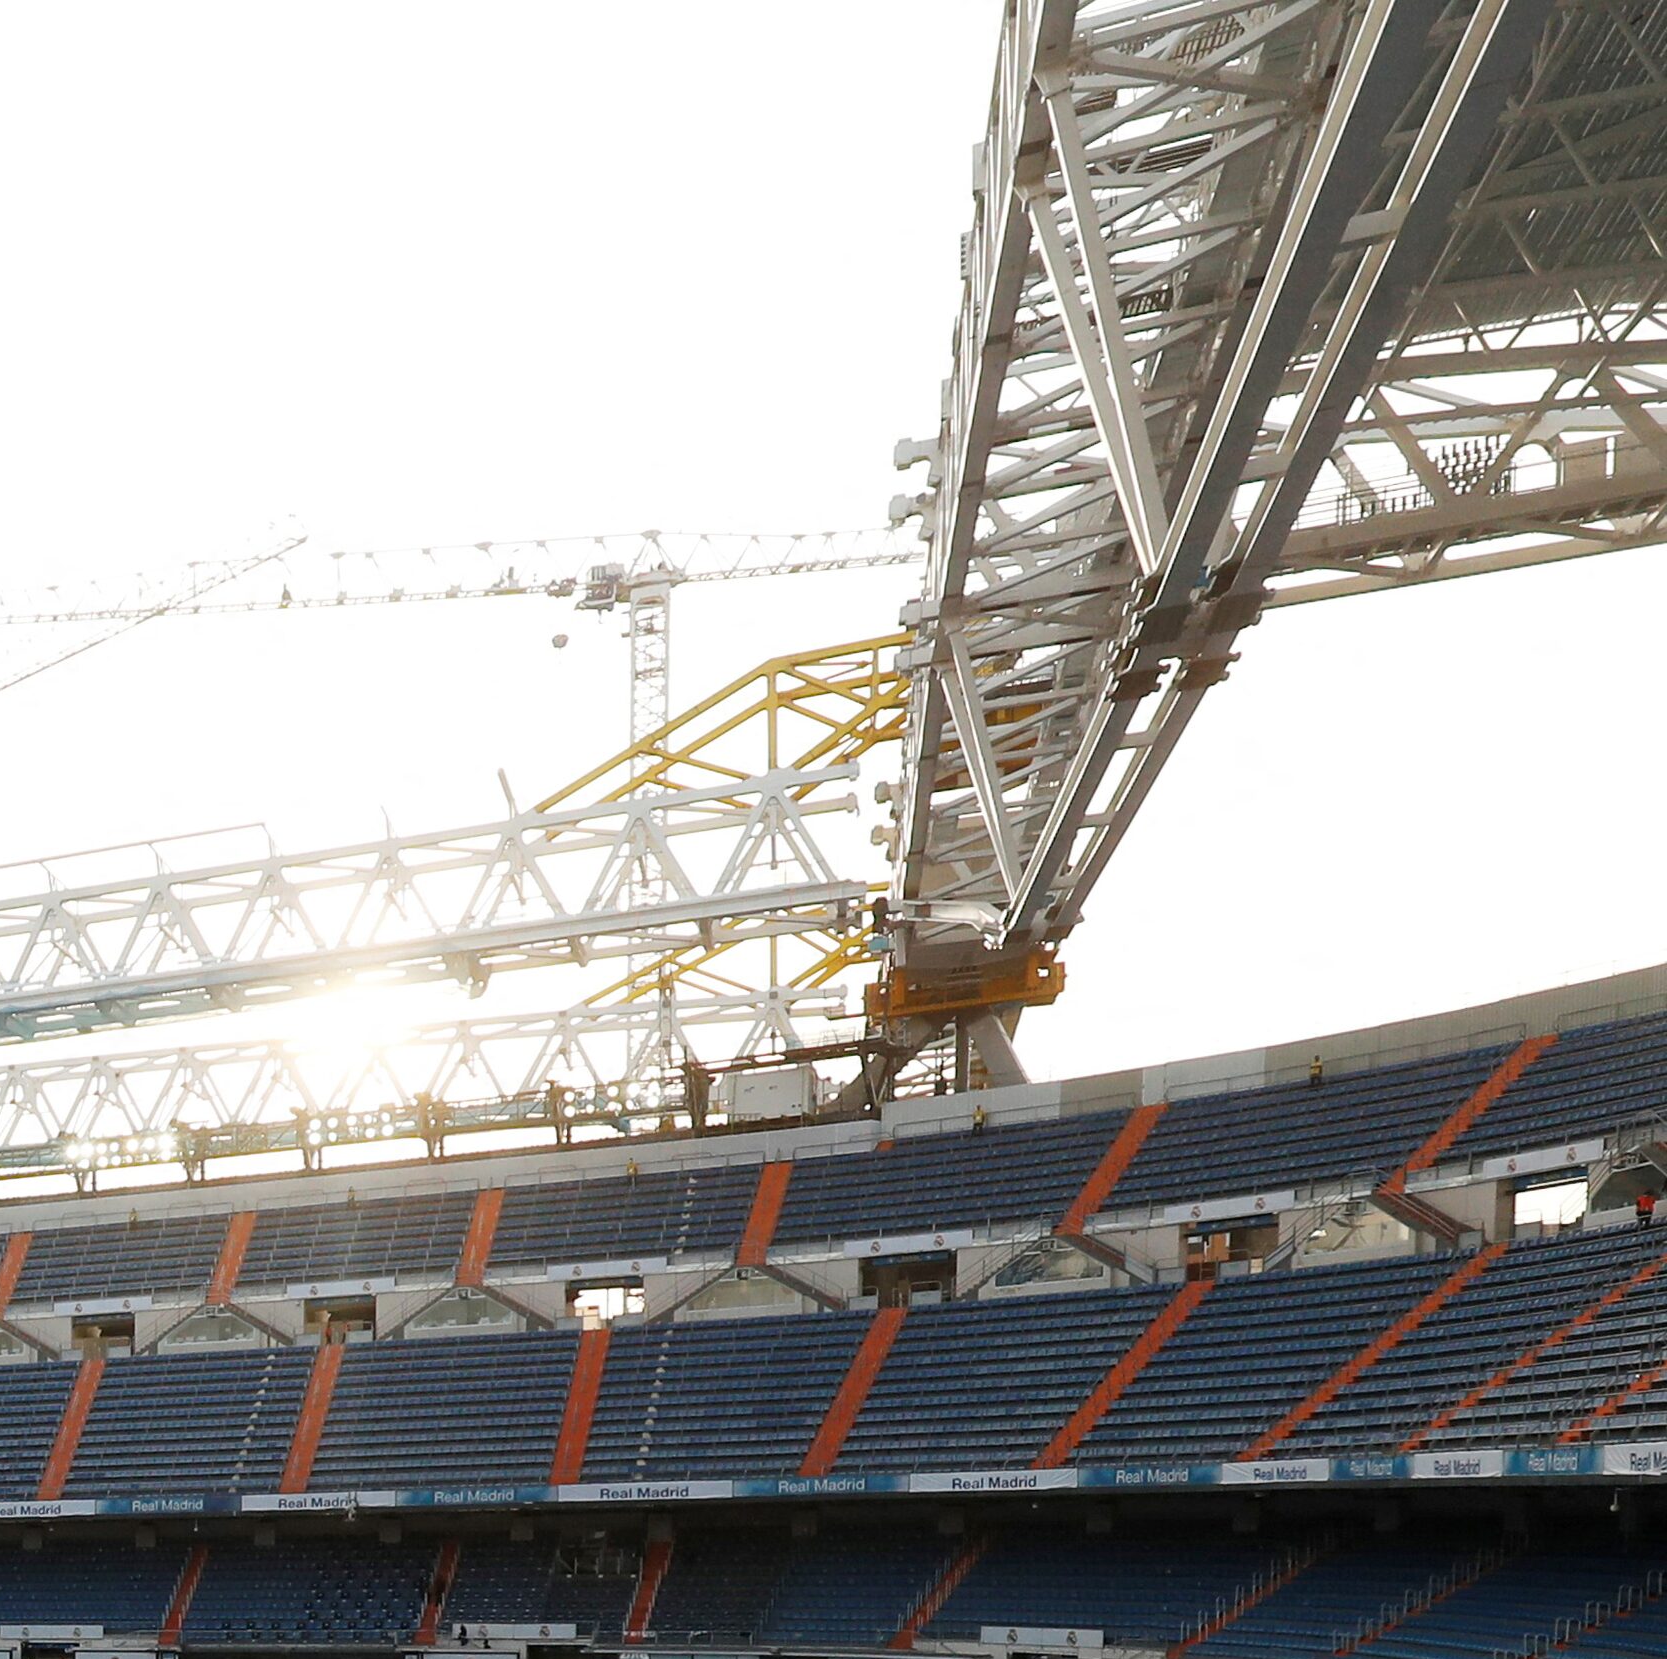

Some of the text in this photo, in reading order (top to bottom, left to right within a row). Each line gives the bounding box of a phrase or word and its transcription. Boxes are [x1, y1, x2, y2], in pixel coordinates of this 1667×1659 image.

[1433, 1460, 1481, 1476] Real Madrid
[1630, 1452, 1652, 1471] Real
[1116, 1468, 1189, 1484] Real Madrid
[1254, 1466, 1307, 1481] Real Madrid
[778, 1478, 865, 1493] Real Madrid
[952, 1476, 1037, 1490] Real Madrid
[434, 1490, 515, 1502] Real Madrid
[600, 1486, 689, 1500] Real Madrid
[21, 1504, 61, 1516] Madrid
[133, 1499, 203, 1511] Real Madrid
[279, 1498, 308, 1509] Real
